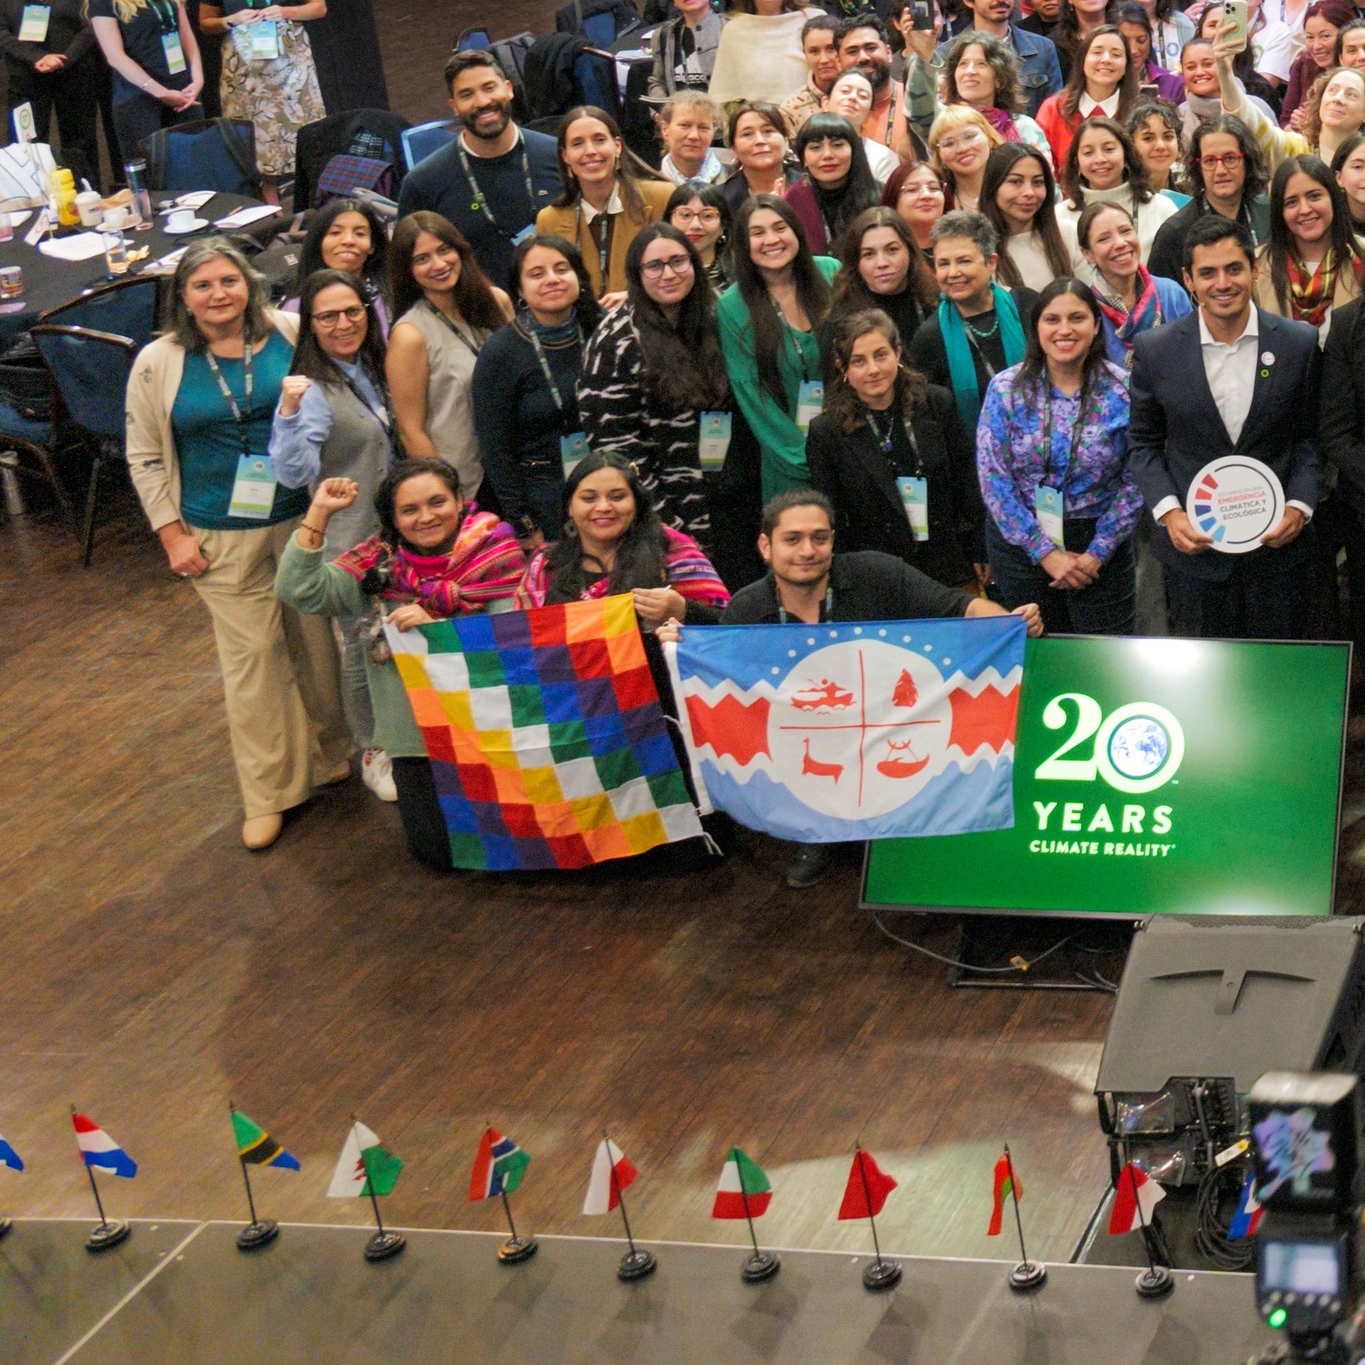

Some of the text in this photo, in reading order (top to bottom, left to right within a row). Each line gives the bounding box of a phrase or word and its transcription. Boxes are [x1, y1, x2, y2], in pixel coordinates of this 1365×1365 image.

[1218, 491, 1266, 505] EMERGENCIA
[1220, 500, 1260, 513] CLIMÁTICA
[1223, 507, 1267, 520] ECOLÓGICA
[1034, 692, 1185, 794] 20
[1033, 801, 1173, 835] YEARS
[1029, 839, 1099, 856] CLIMATE
